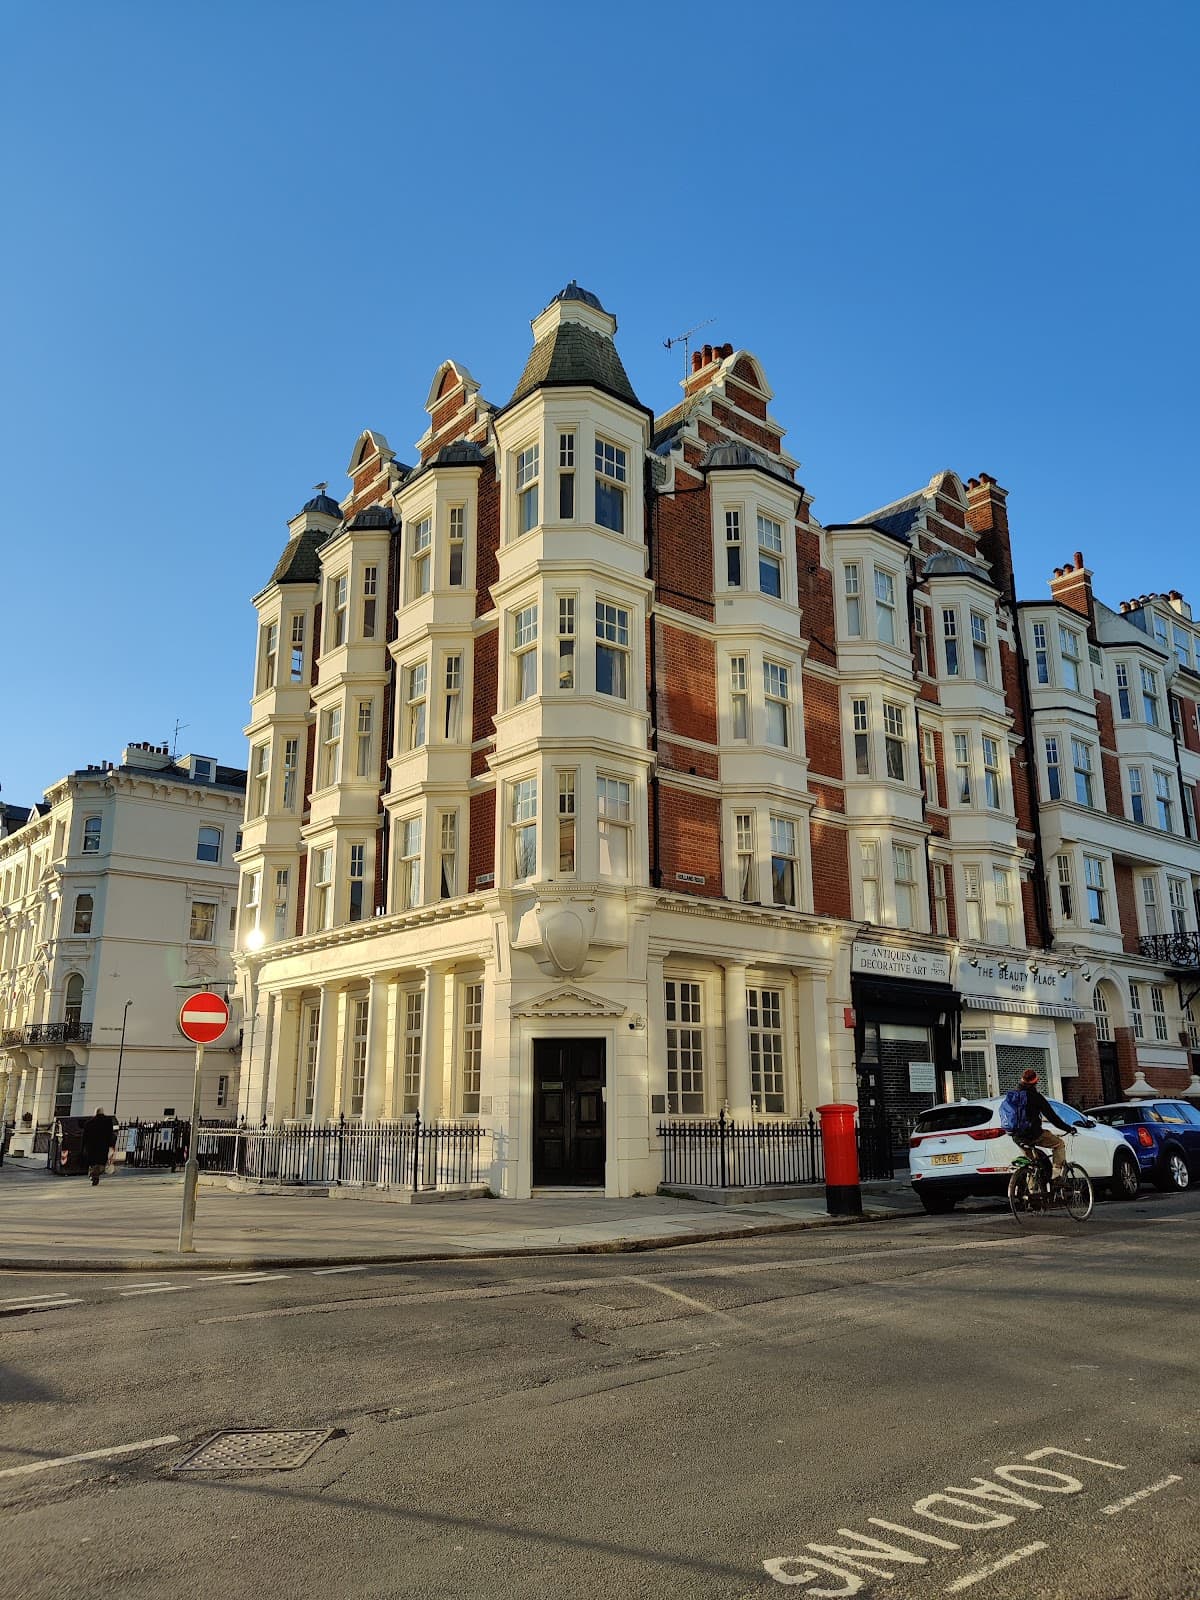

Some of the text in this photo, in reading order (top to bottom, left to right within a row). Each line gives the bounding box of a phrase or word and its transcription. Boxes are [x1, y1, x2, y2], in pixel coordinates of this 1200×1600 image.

[871, 948, 911, 962] ANTIQUES
[860, 959, 911, 974] DECORATIVE
[912, 967, 927, 976] ART
[977, 966, 1057, 987] THE BEAUTY PLACE
[1011, 983, 1025, 993] HOVE
[762, 1445, 1128, 1598] LOADING
